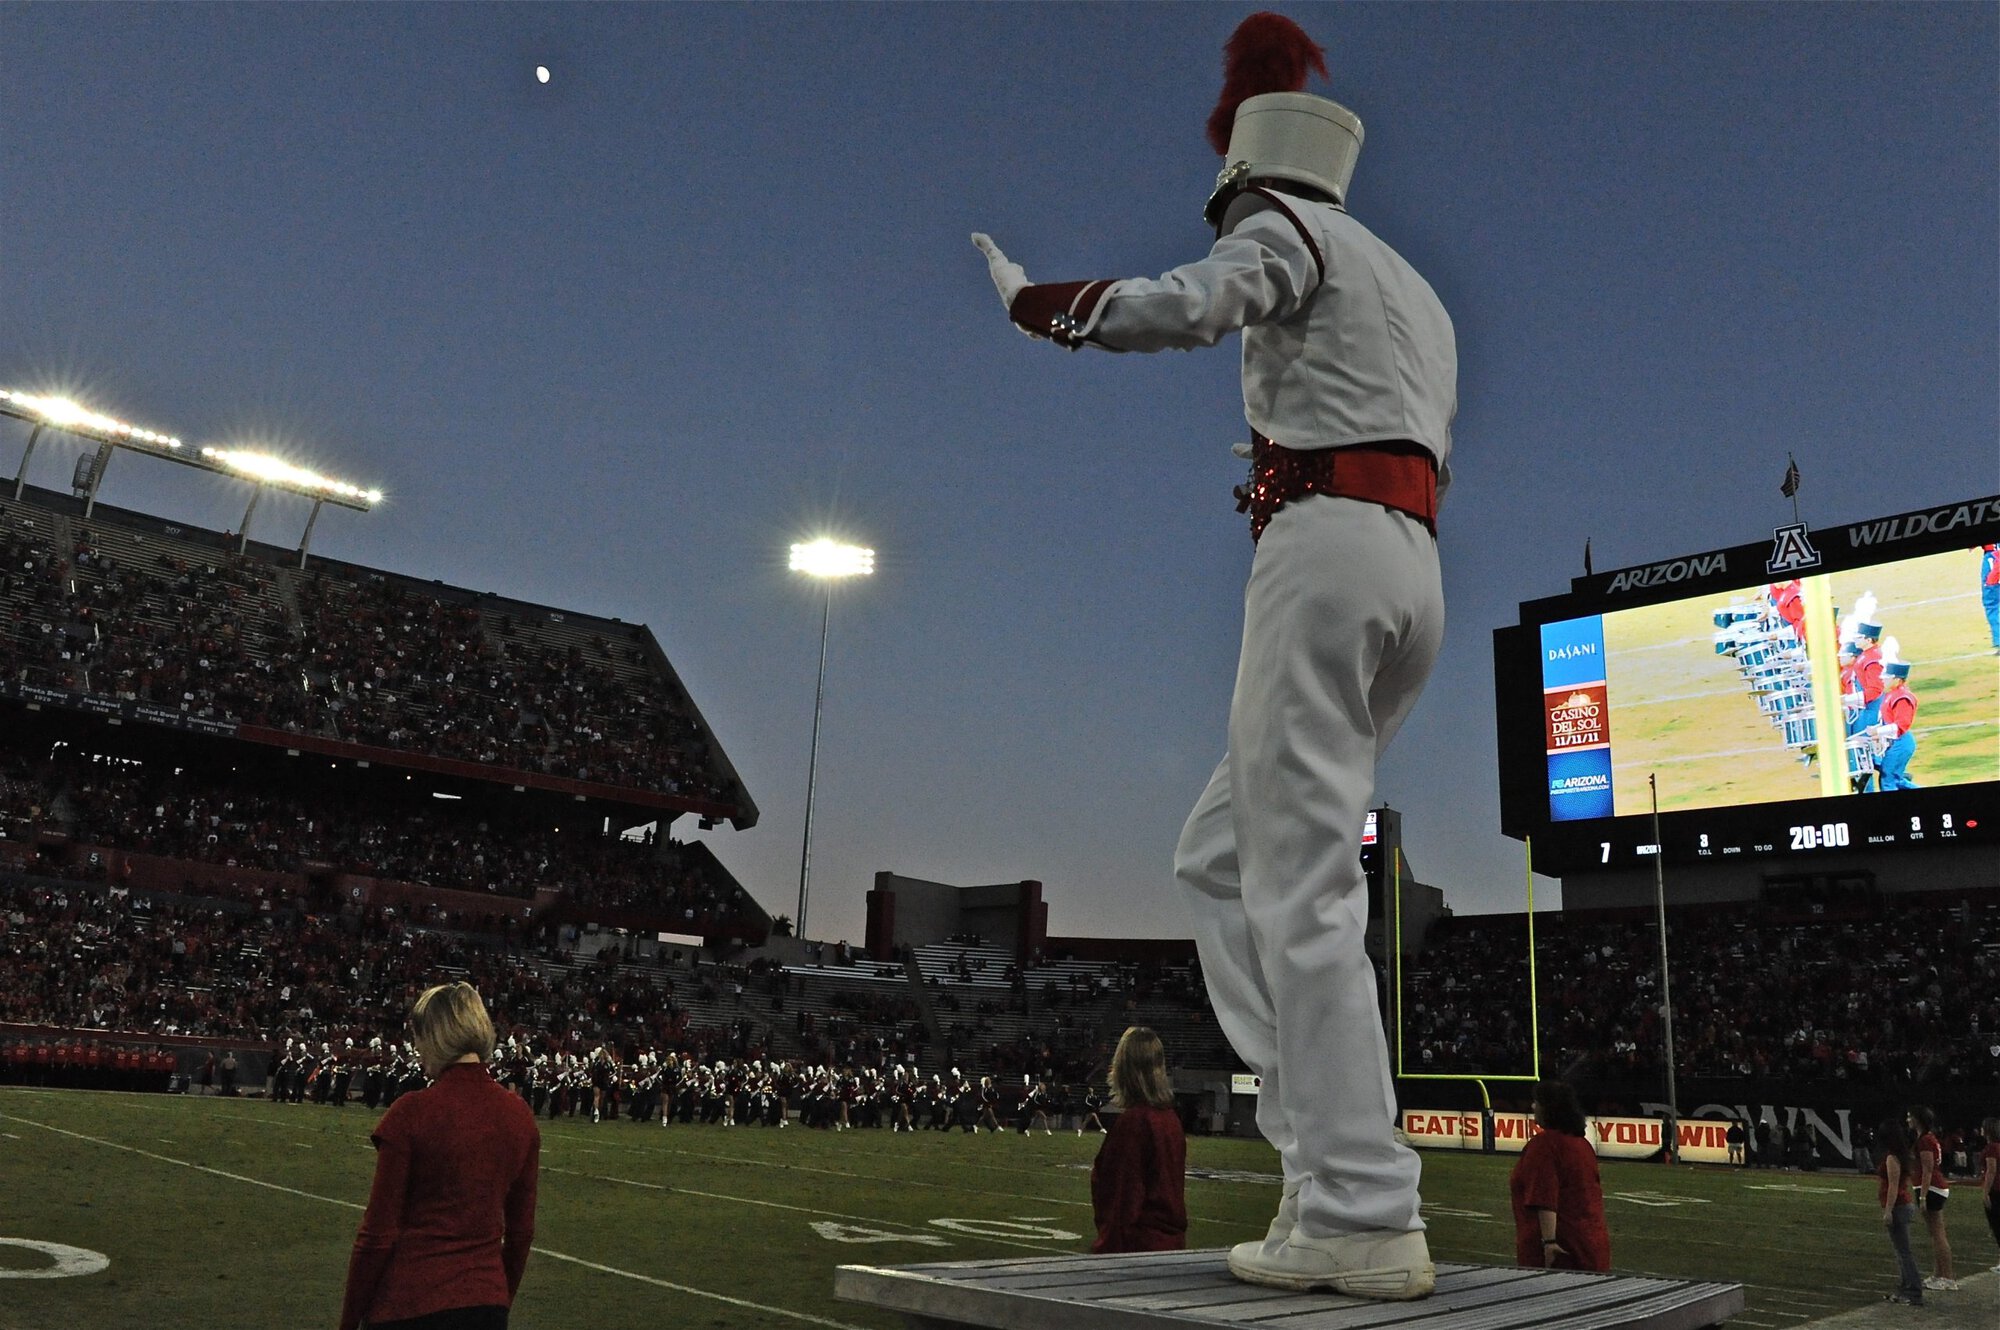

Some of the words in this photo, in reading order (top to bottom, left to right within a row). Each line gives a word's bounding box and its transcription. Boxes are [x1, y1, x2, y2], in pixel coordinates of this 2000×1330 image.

[1606, 553, 1727, 595] ARIZONA
[1848, 498, 2000, 548] WILDCATS
[1548, 643, 1597, 662] DASANI
[1551, 706, 1600, 722] CASINO
[1552, 720, 1578, 735] DEL
[1578, 717, 1602, 731] SOL
[1555, 734, 1600, 747] 11/11/11
[1564, 774, 1607, 788] ARIZONA
[1789, 821, 1850, 850] 20:00
[1868, 835, 1884, 844] BALL
[1884, 834, 1895, 843] ON
[1910, 831, 1924, 840] QTR
[90, 852, 98, 863] 5
[1600, 842, 1611, 863] 7
[1723, 846, 1741, 854] DOWN
[1406, 1114, 1479, 1137] CATS
[1596, 1121, 1662, 1145] YOU
[1640, 1102, 1853, 1160] WN
